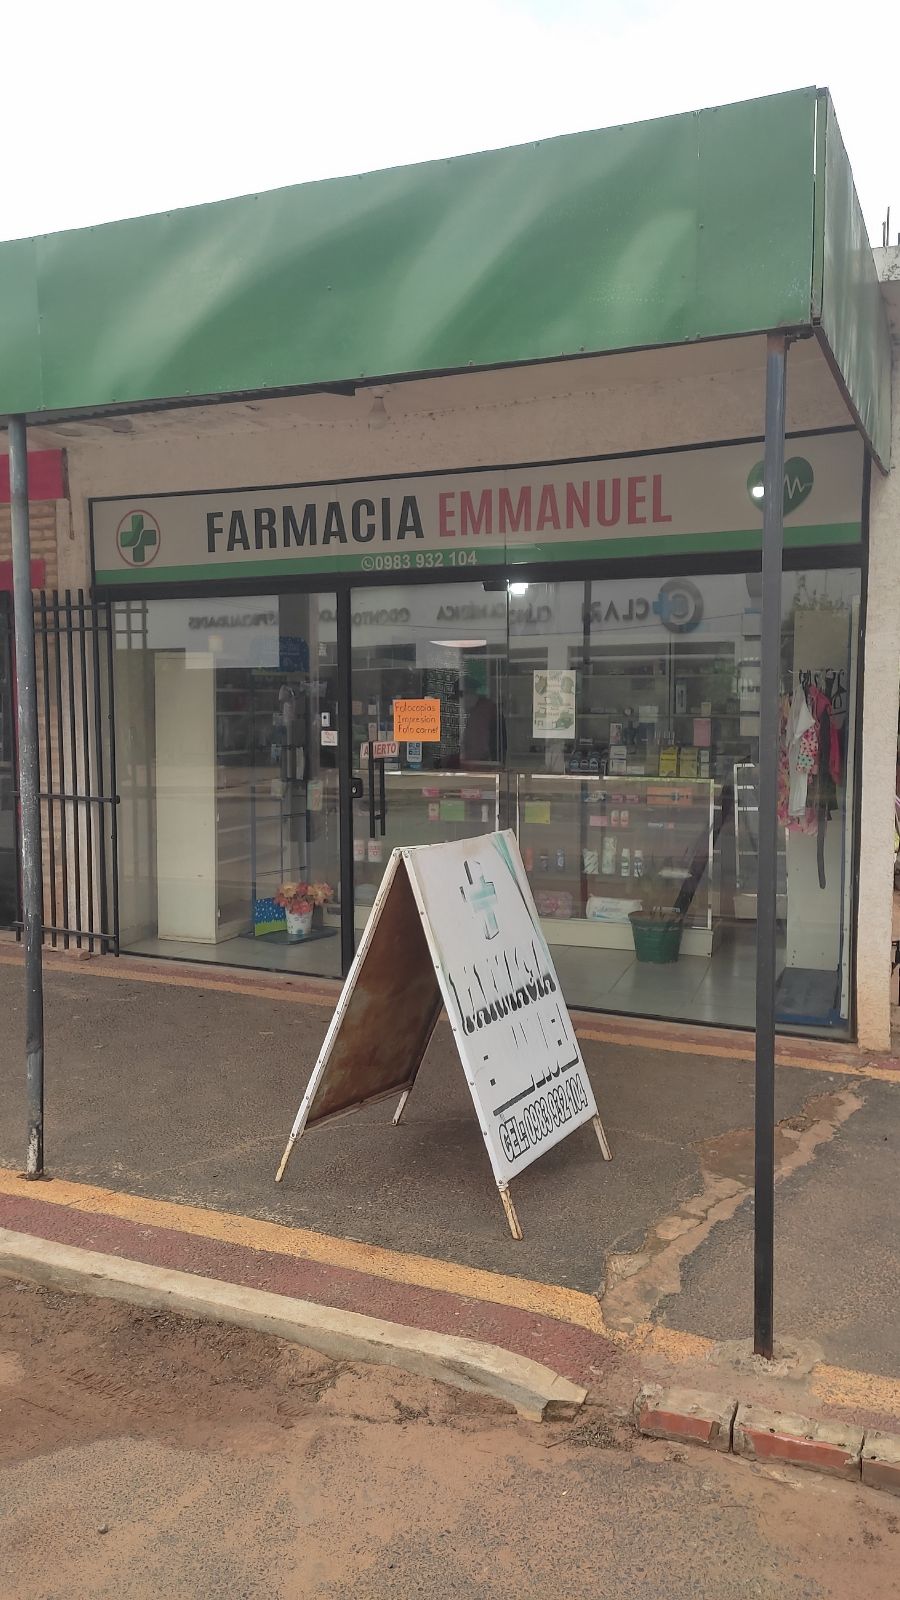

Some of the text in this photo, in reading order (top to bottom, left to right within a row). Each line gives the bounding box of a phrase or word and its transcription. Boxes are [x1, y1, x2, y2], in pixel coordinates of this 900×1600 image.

[206, 474, 673, 553] FARMACIA EMMANUEL
[375, 550, 478, 571] 0983 932 104
[363, 742, 397, 756] AIERTO
[499, 1115, 531, 1163] CEL:
[523, 1096, 554, 1145] 0983
[547, 1084, 573, 1128] 932
